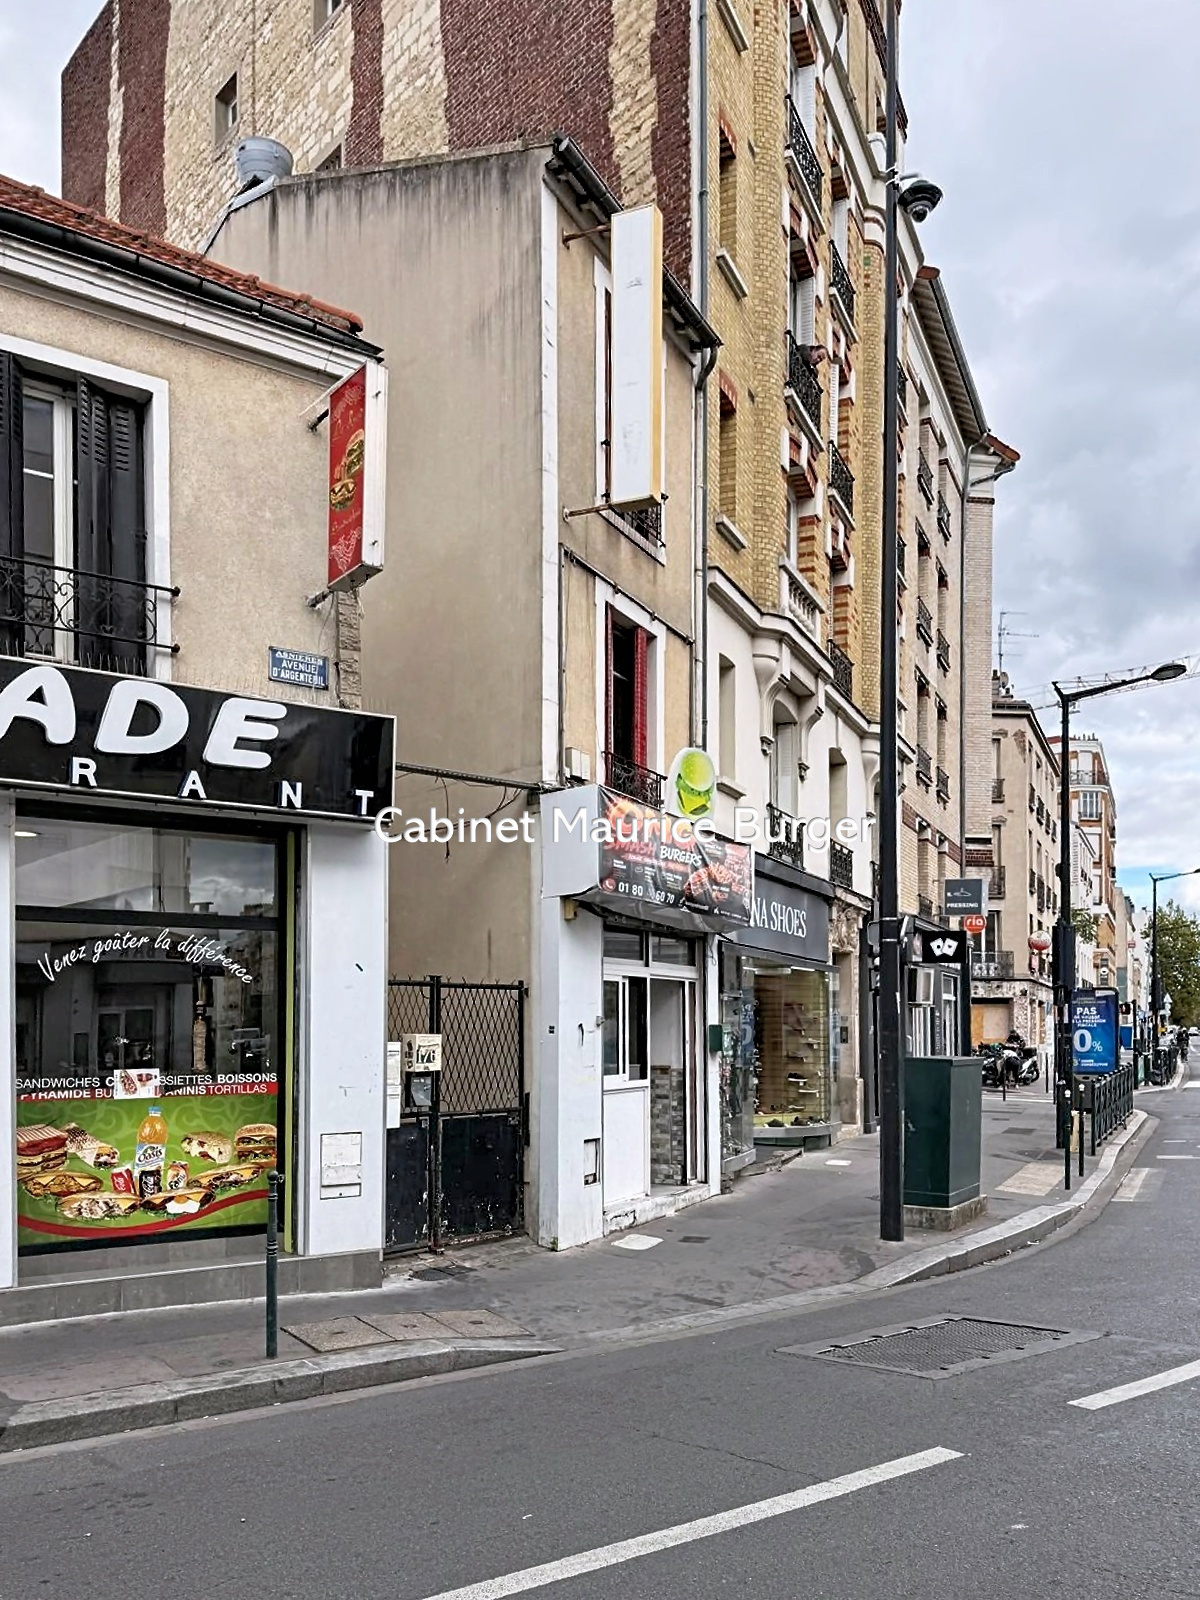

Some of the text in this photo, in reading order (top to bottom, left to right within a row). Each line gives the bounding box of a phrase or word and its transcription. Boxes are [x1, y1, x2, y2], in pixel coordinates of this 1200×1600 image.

[281, 660, 318, 674] AVENUE
[272, 667, 325, 686] D'ARGENTEUIL
[0, 666, 287, 769] ADE
[660, 845, 703, 867] BURGERS
[618, 881, 629, 893] 01
[631, 884, 643, 897] 80
[770, 901, 807, 938] SHOES
[966, 916, 984, 926] ria
[37, 927, 253, 984] Venez goûter la différence
[1076, 1007, 1097, 1015] PAS
[15, 1077, 101, 1089] SANDWICHES
[217, 1073, 277, 1084] BOISSONS
[95, 1088, 114, 1098] BU
[208, 1084, 268, 1094] TORTILLAS
[138, 1147, 163, 1163] Oasis
